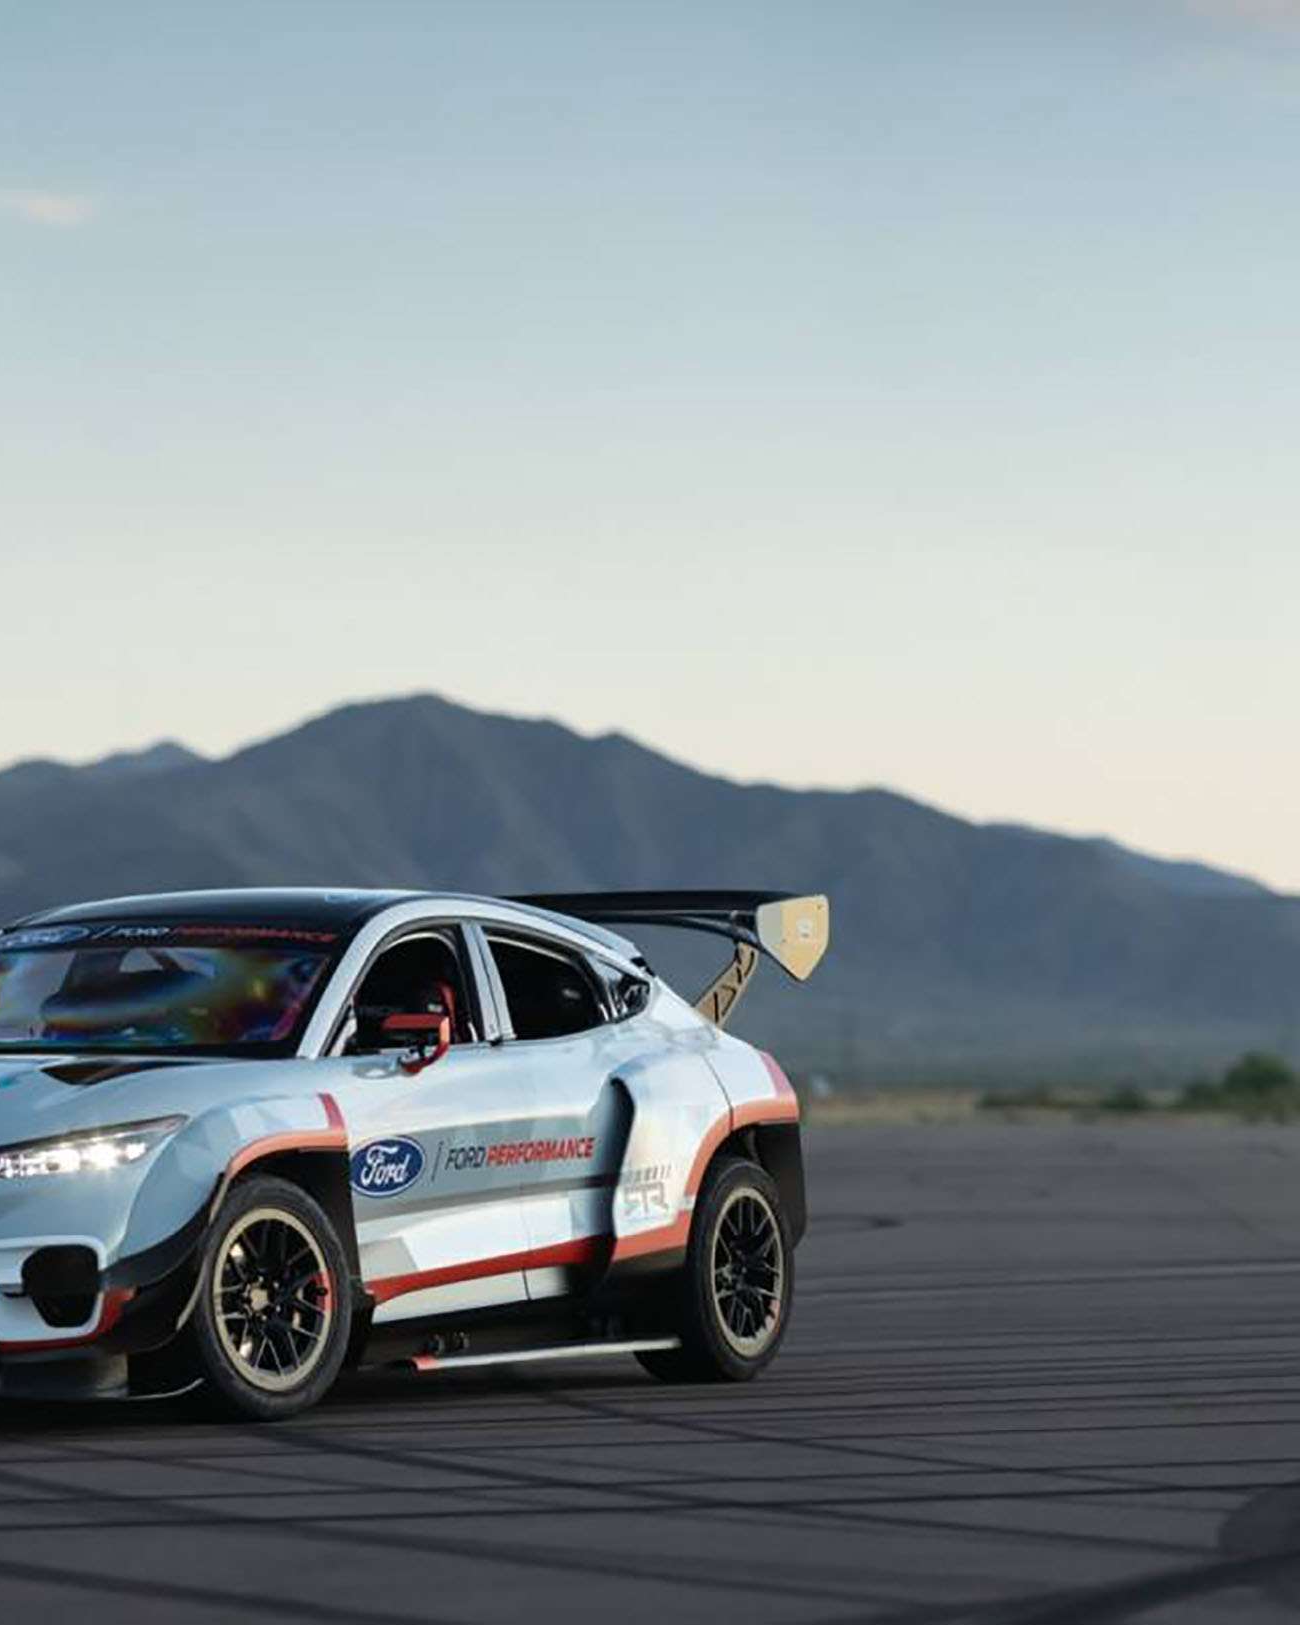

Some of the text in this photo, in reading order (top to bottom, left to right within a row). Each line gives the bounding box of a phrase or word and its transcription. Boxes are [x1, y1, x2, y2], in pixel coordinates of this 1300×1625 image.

[360, 1145, 410, 1185] Ford
[445, 1137, 595, 1170] FORD PERFORMANCE
